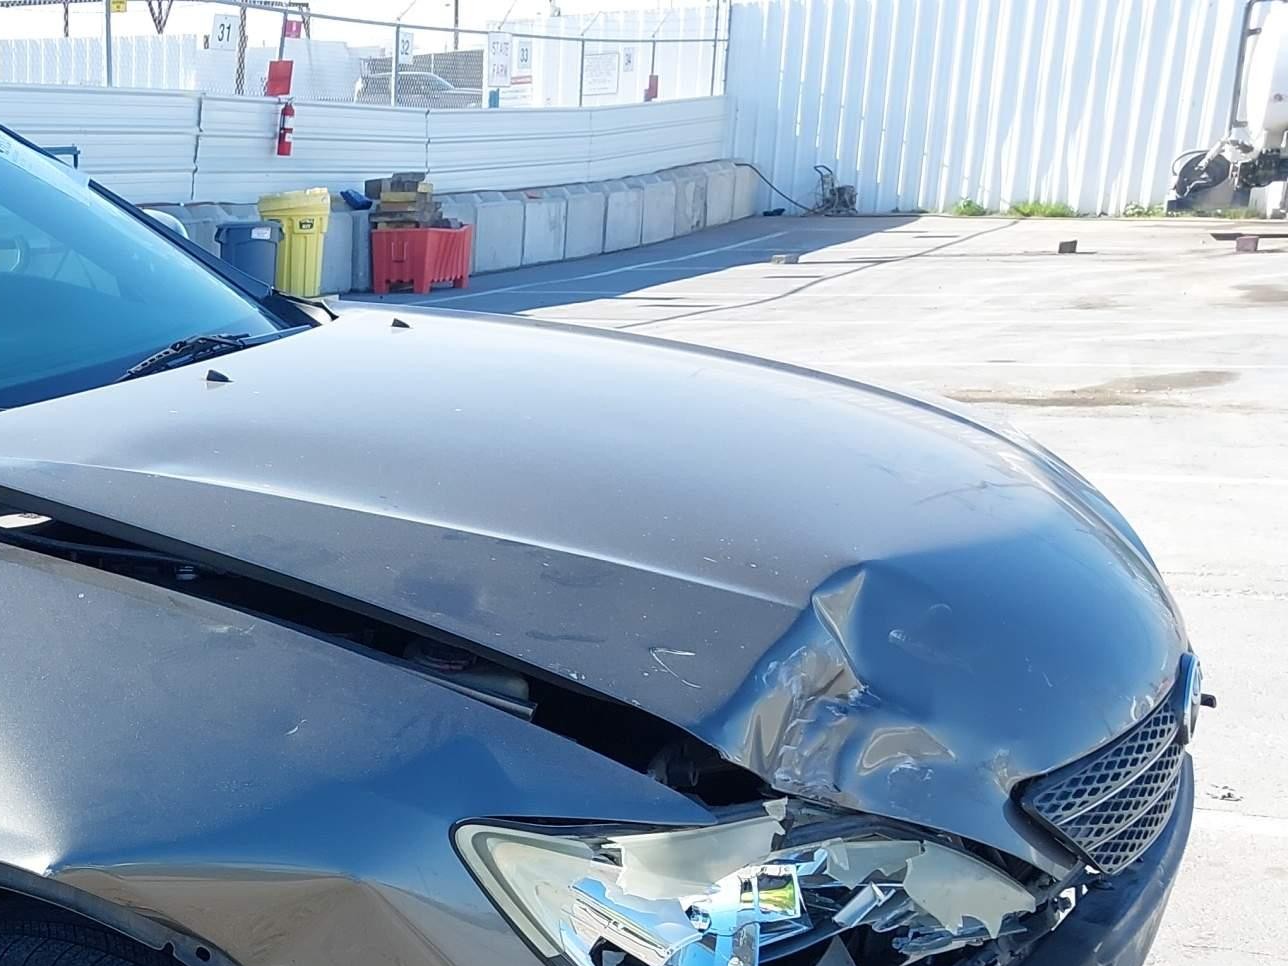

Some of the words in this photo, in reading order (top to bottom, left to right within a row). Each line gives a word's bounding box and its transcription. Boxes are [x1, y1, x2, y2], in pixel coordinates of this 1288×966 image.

[217, 23, 231, 42] 31
[400, 40, 410, 55] 32
[492, 41, 509, 56] STATE
[519, 47, 529, 63] 33
